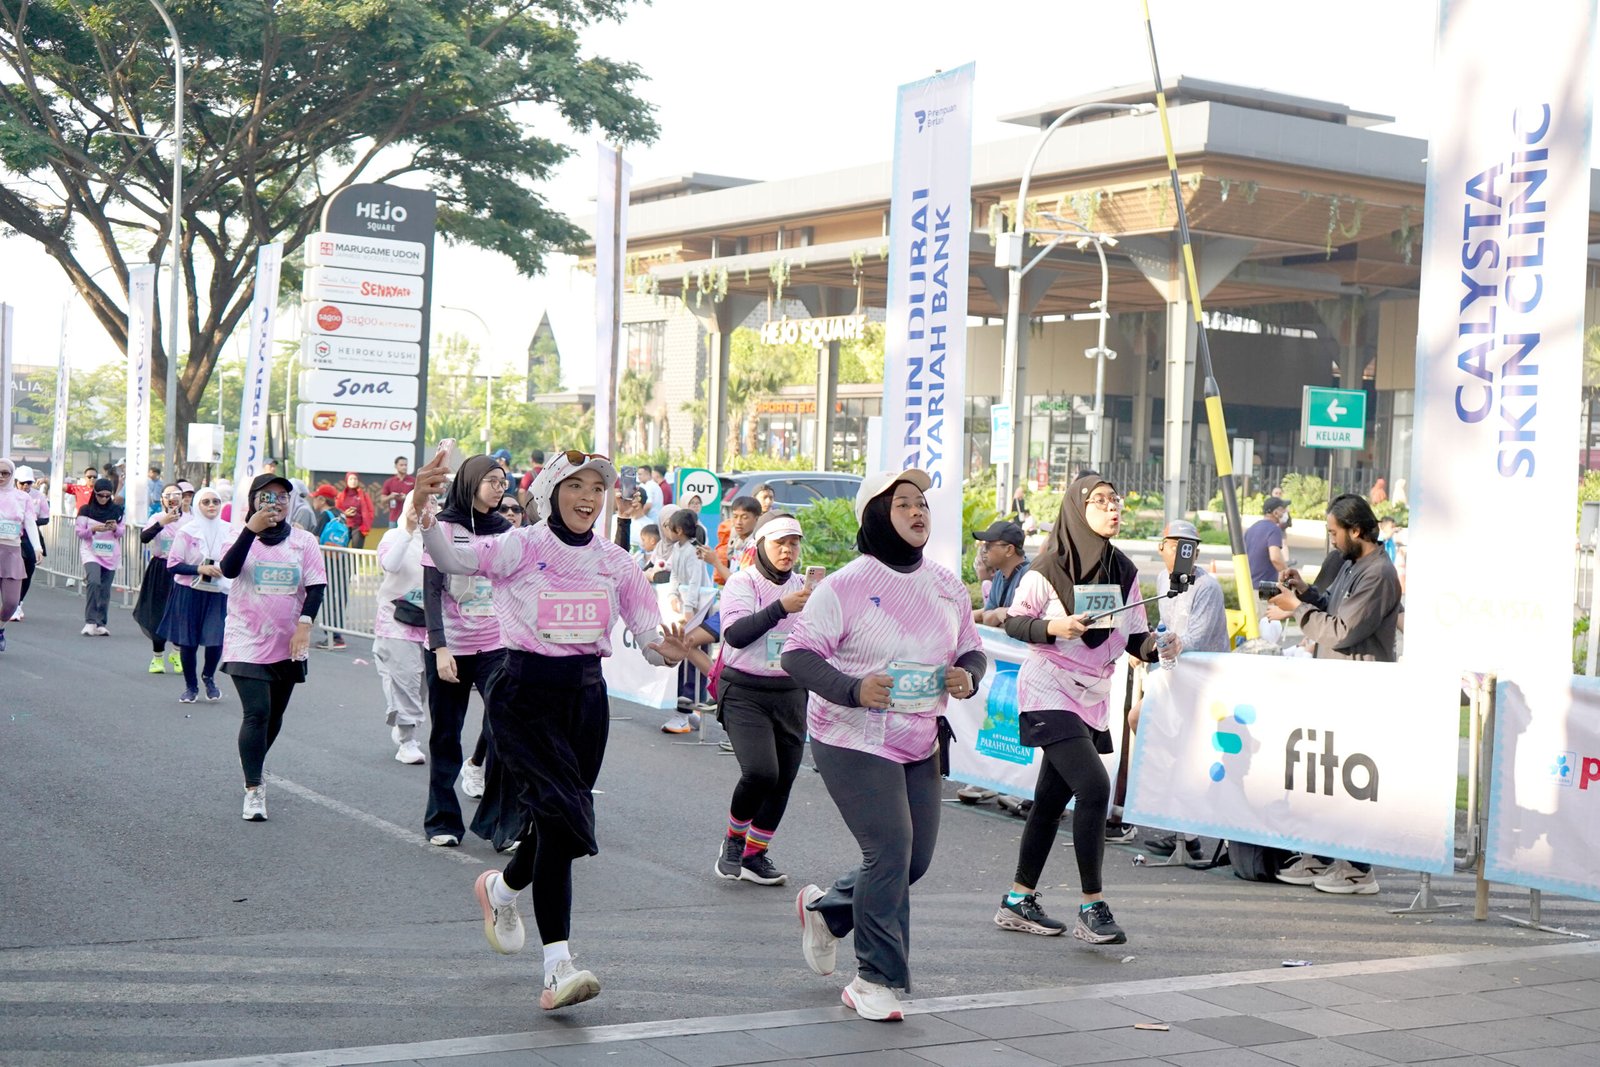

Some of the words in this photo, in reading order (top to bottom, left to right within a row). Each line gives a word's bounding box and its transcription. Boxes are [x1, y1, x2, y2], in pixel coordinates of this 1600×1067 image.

[1505, 102, 1551, 314] CLINIC
[367, 221, 396, 232] SQUARE
[335, 243, 390, 258] MARUGAME
[392, 248, 420, 260] UDON
[931, 203, 952, 315] BANK
[1455, 162, 1504, 424] CALYSTA
[346, 315, 378, 326] sagoo
[800, 315, 866, 350] SQUARE
[338, 347, 383, 357] HEIROKU
[388, 350, 416, 359] SUSHI
[333, 378, 394, 398] Sona
[925, 325, 947, 489] SYARIAH
[1497, 332, 1541, 478] SKIN
[342, 417, 387, 430] Bakmi
[389, 420, 413, 432] GM
[1316, 431, 1351, 442] KELUAR
[687, 484, 714, 494] OUT
[262, 569, 294, 581] 6463
[1085, 595, 1117, 610] 7573
[553, 603, 597, 621] 1218
[980, 737, 1031, 757] PARAHYANGAN
[1284, 727, 1380, 803] fita
